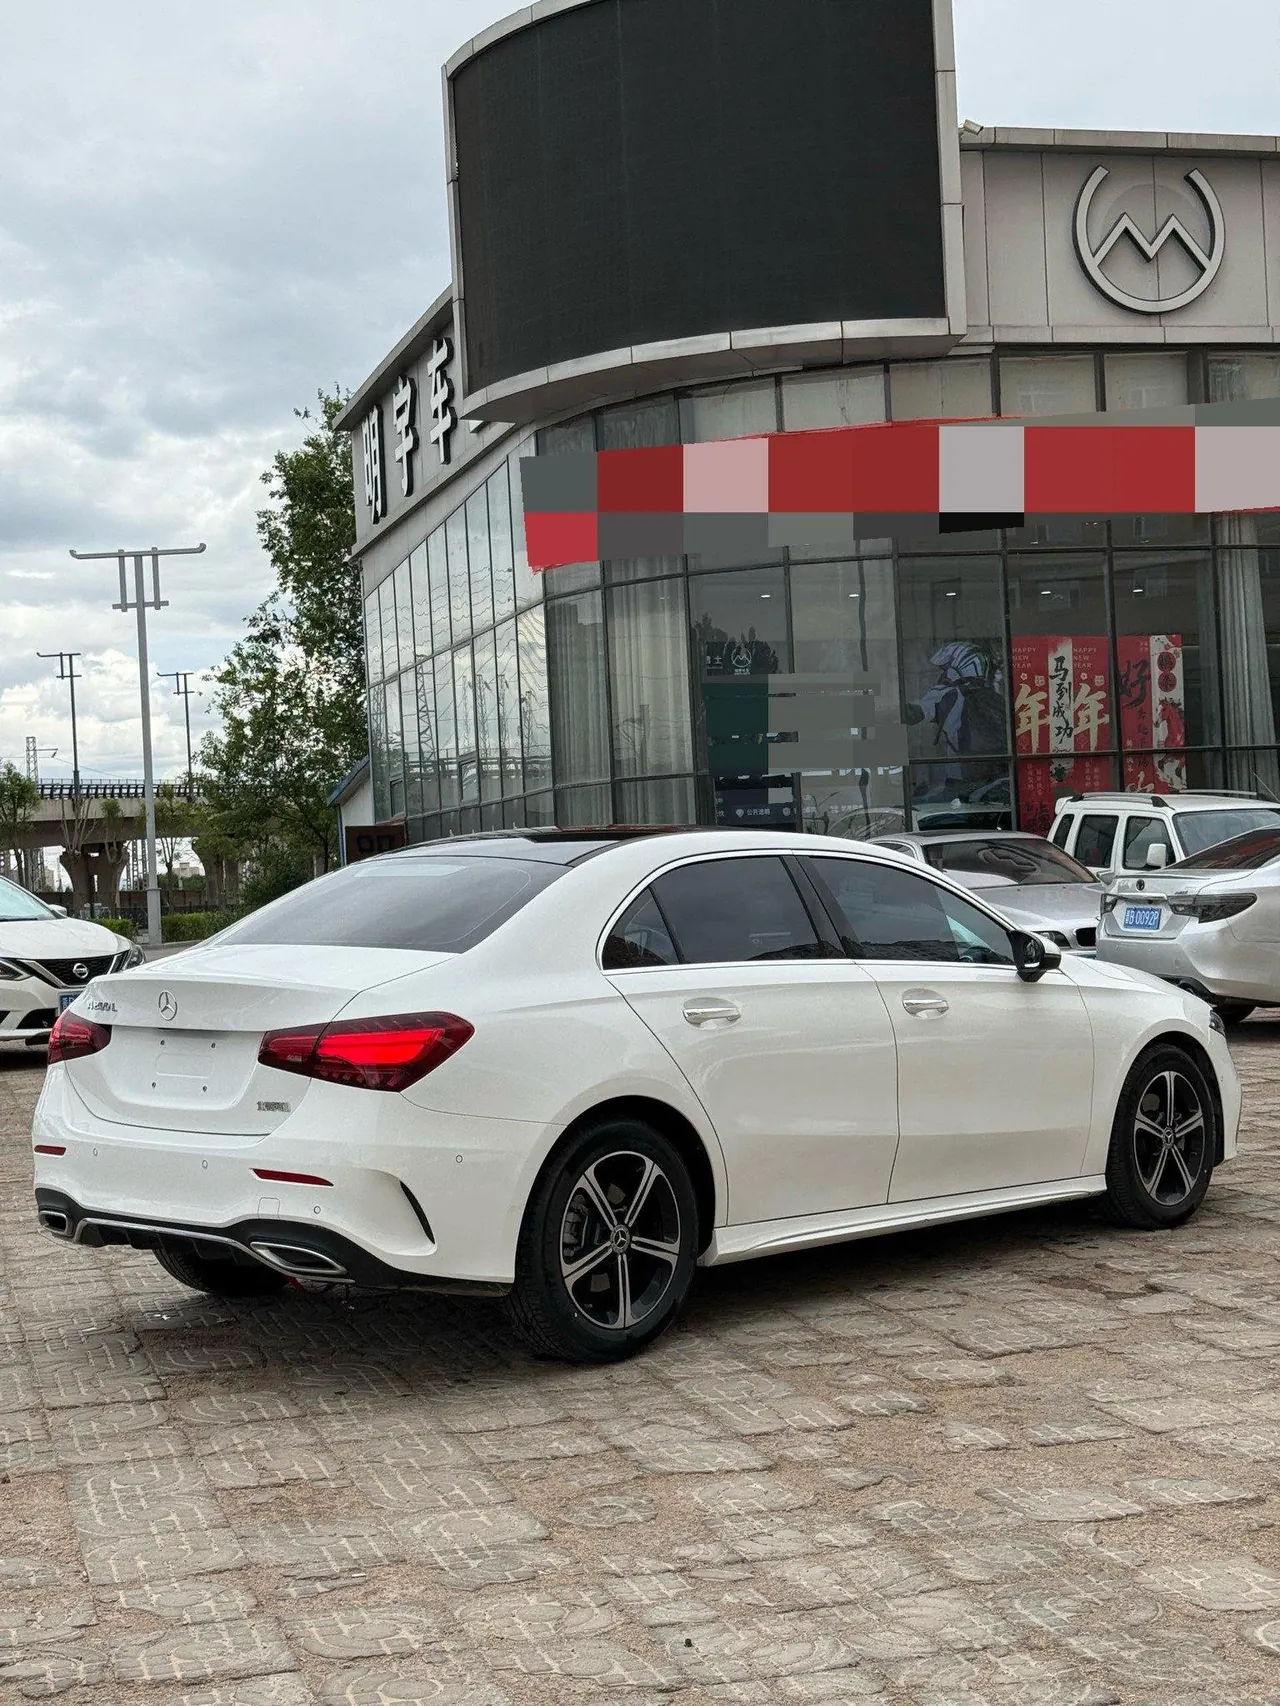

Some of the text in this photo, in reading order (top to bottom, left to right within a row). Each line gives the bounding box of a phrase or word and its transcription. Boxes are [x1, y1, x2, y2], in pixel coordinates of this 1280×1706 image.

[361, 336, 486, 524] 明宇车
[1049, 655, 1073, 744] 马到成功
